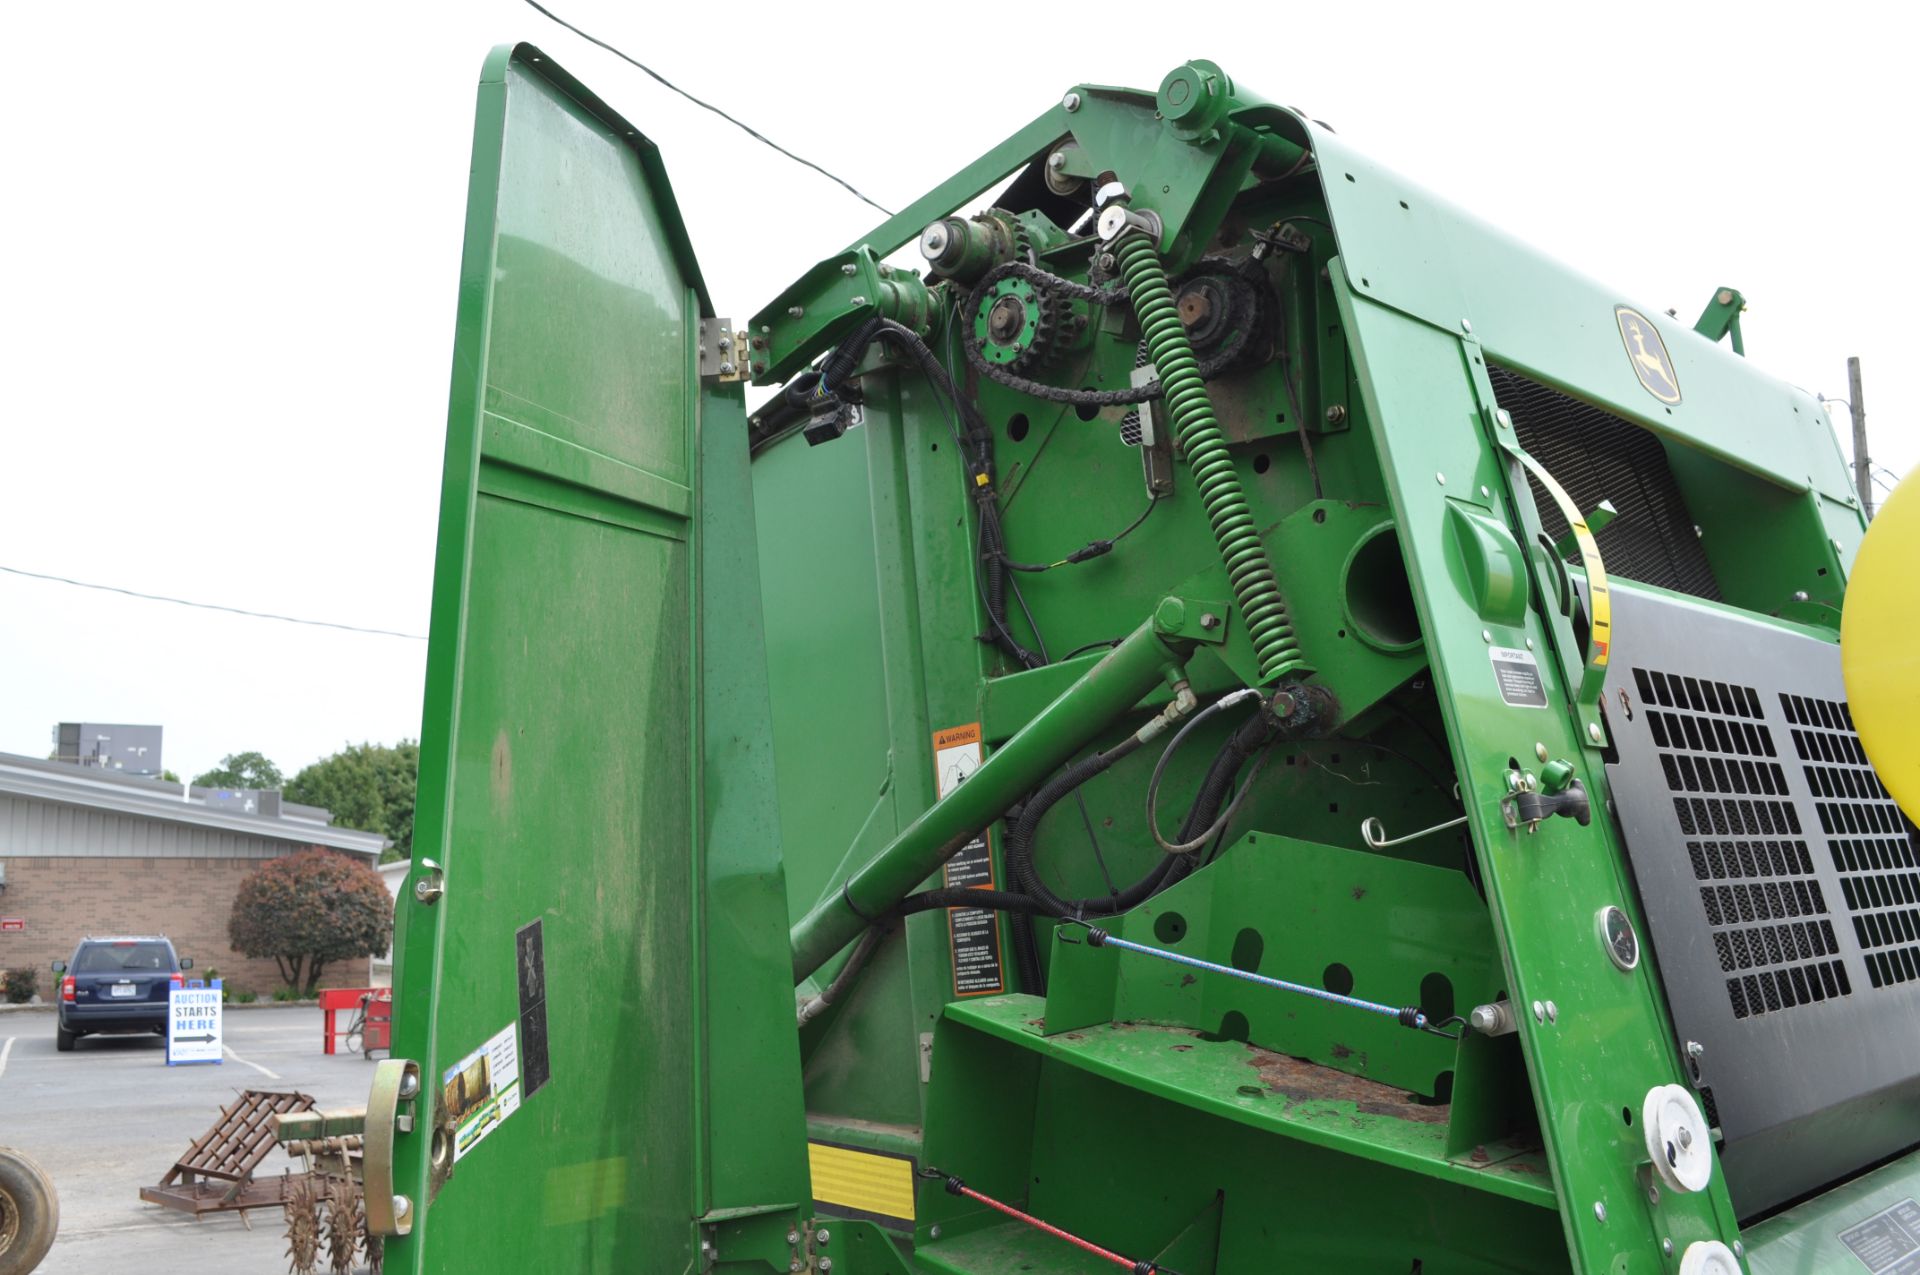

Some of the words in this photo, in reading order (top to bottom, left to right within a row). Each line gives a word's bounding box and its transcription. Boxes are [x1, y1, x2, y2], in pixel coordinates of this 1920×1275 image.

[945, 729, 976, 743] WARNING
[175, 993, 217, 1004] AUCTION
[176, 1006, 217, 1018] STARTS
[176, 1019, 216, 1031] HERE
